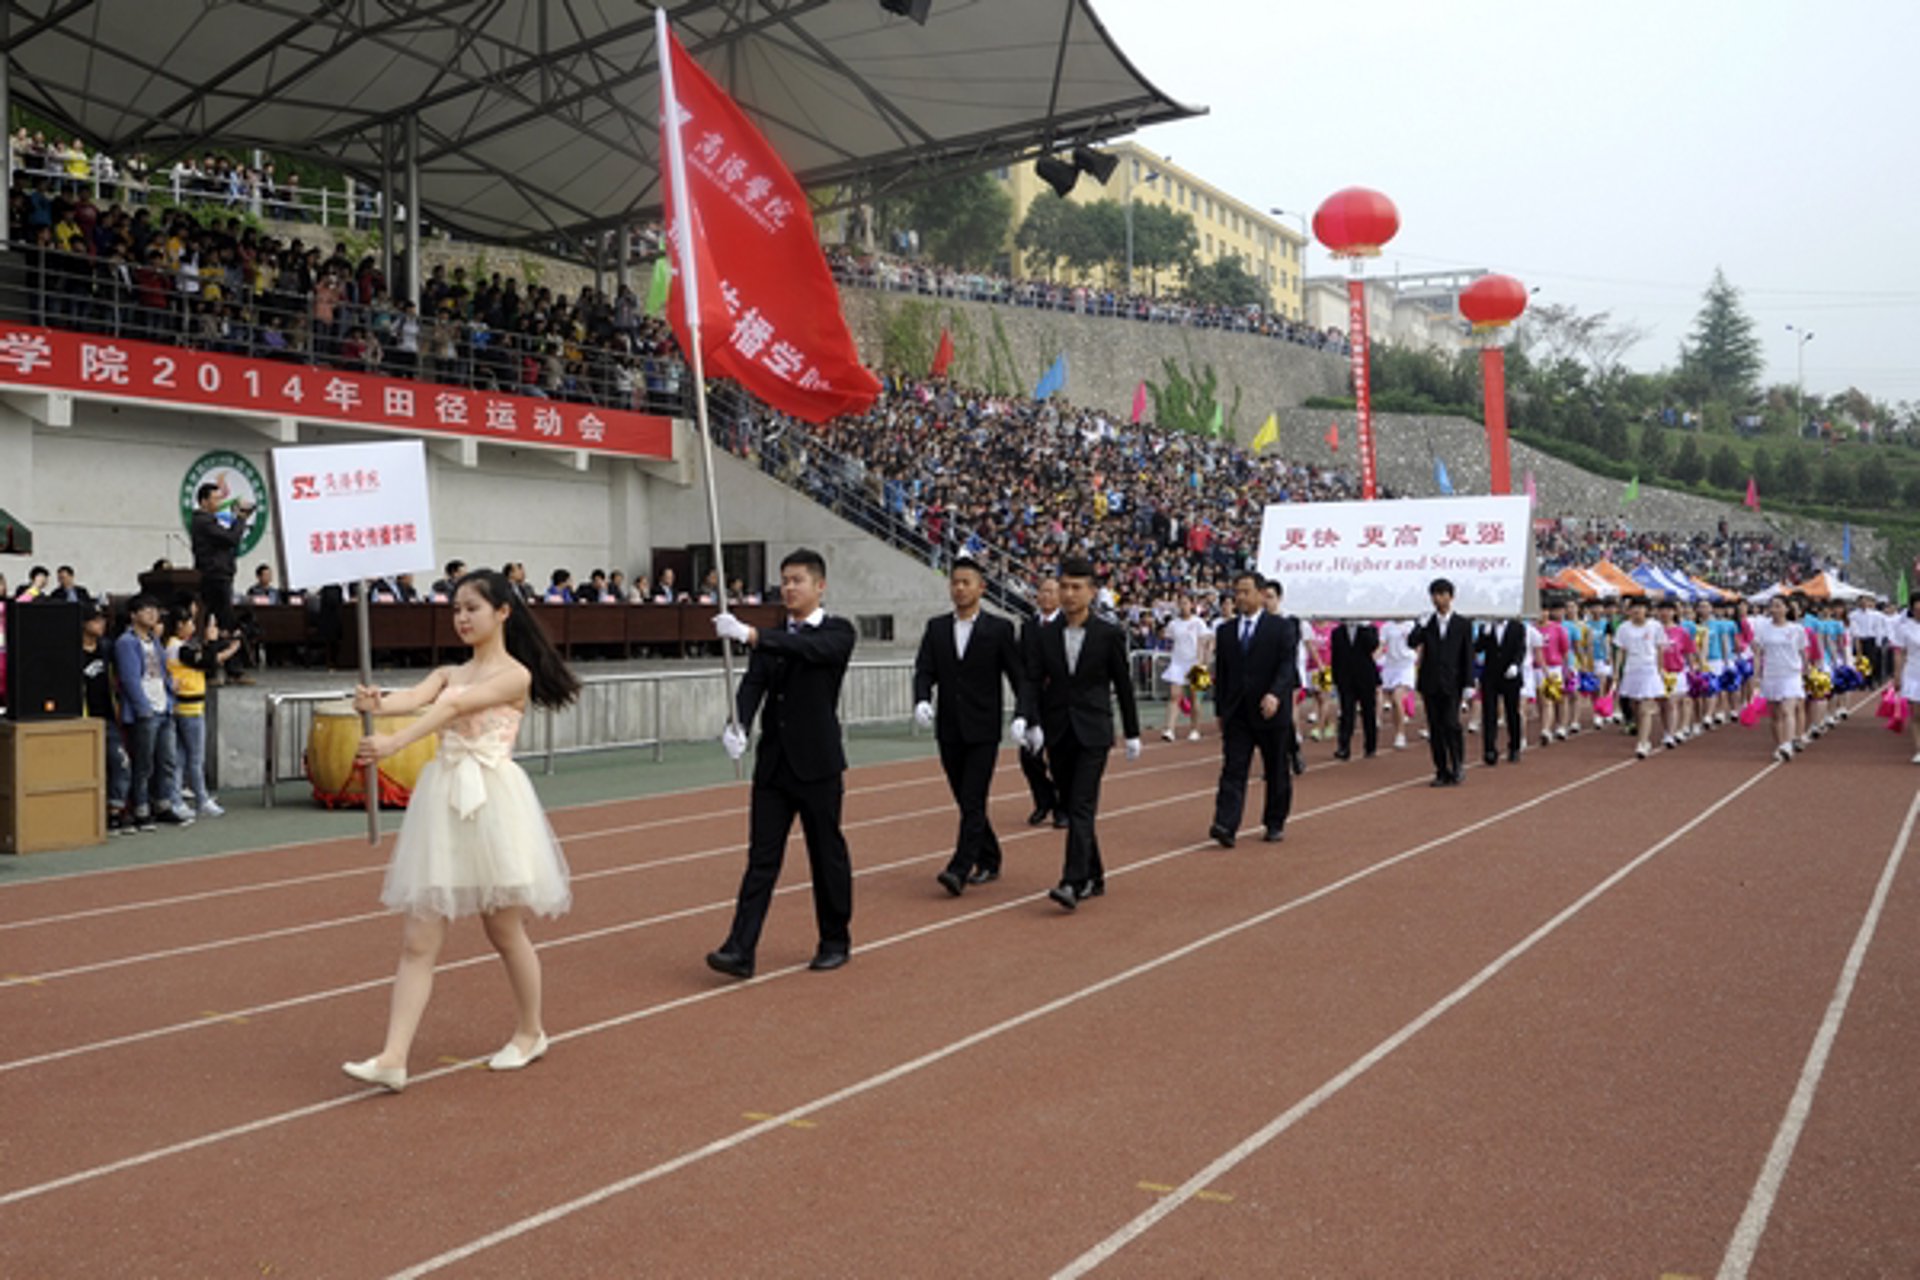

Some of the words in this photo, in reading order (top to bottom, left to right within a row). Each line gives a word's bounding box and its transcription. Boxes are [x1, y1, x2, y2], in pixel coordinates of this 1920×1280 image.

[0, 333, 606, 442] 学院2014年田径运动会
[1279, 527, 1341, 551] 更快
[1357, 524, 1422, 549] 更高
[1439, 521, 1505, 546] 更强
[1394, 555, 1428, 571] and
